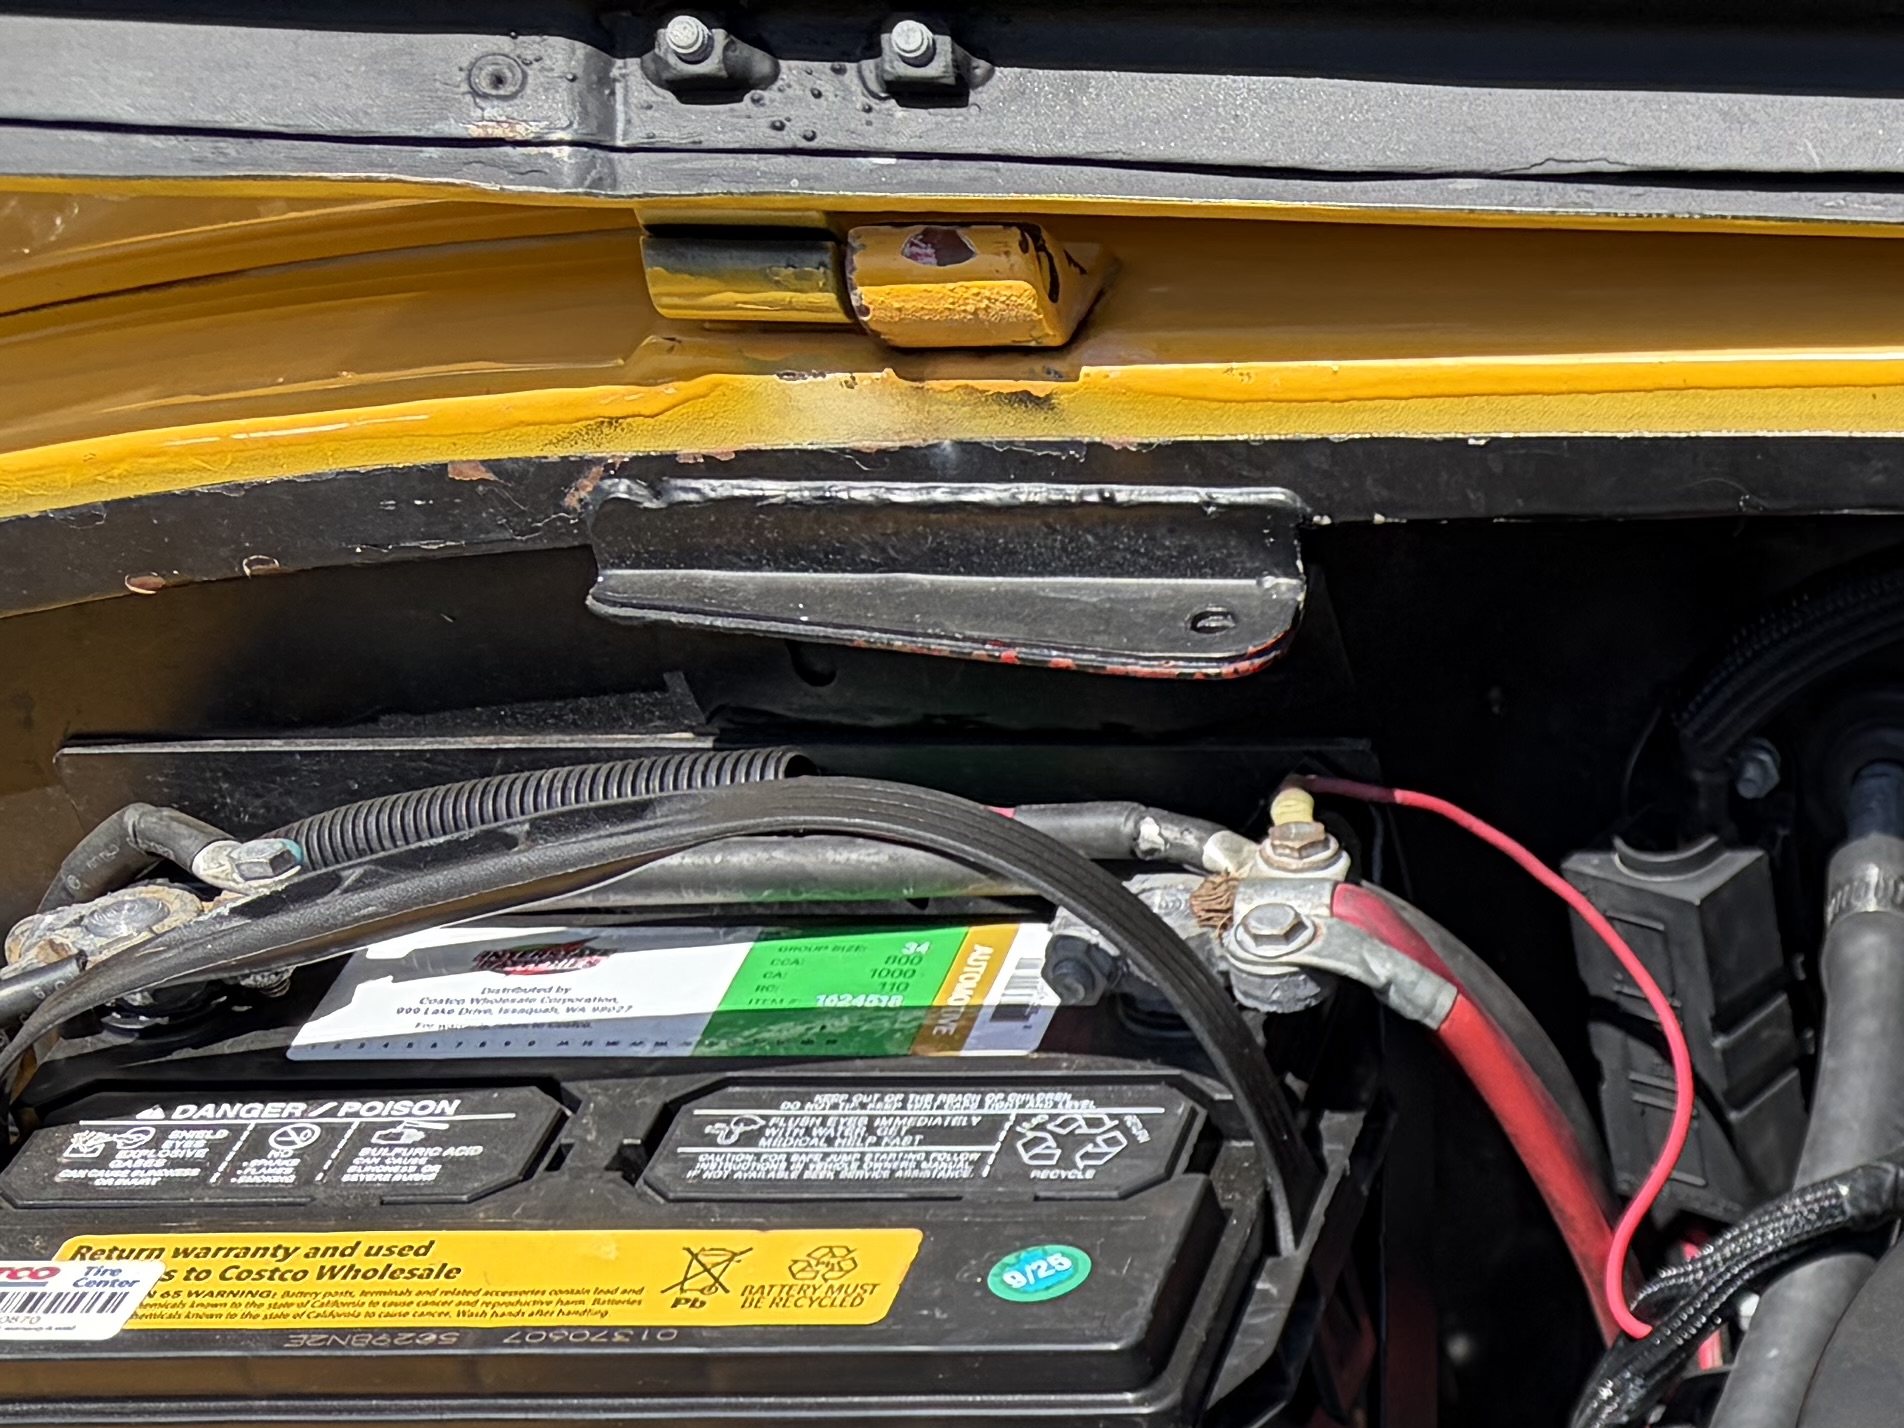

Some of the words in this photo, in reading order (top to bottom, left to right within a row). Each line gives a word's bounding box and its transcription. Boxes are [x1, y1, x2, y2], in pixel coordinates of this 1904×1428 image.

[901, 942, 931, 955] 34
[869, 968, 915, 979] 1000
[878, 982, 909, 993] 110
[933, 945, 994, 1036] AUTOMOTIVE
[565, 1005, 587, 1014] WA
[171, 1103, 307, 1121] DANGER
[340, 1100, 461, 1117] POISON
[769, 1117, 823, 1127] FLUSH
[874, 1116, 982, 1127] IMMEDIATELY
[764, 1127, 809, 1137] WITH
[759, 1137, 828, 1147] MEDICAL
[833, 1136, 876, 1147] HELP
[115, 1149, 209, 1159] EXPLOSIVE
[267, 1150, 294, 1158] NO
[358, 1147, 441, 1157] SULFURIC
[442, 1146, 484, 1156] ACID
[1030, 1169, 1095, 1179] RECYCLE
[70, 1244, 167, 1263] Return
[172, 1244, 297, 1263] warranty
[303, 1242, 360, 1260] and
[364, 1241, 435, 1259] used
[84, 1266, 122, 1277] Tire
[183, 1266, 209, 1283] to
[217, 1264, 311, 1283] Costco
[314, 1263, 463, 1282] Wholesale
[1003, 1252, 1072, 1289] 9/25
[72, 1278, 141, 1288] Center
[160, 1290, 182, 1298] 65
[415, 1288, 436, 1297] and
[620, 1286, 646, 1296] and
[741, 1284, 822, 1297] BATTERY
[825, 1283, 881, 1296] MUST
[670, 1298, 707, 1309] Pb
[741, 1296, 766, 1309] BE
[769, 1296, 865, 1308] RECYCLED
[502, 1328, 679, 1345] 01370607
